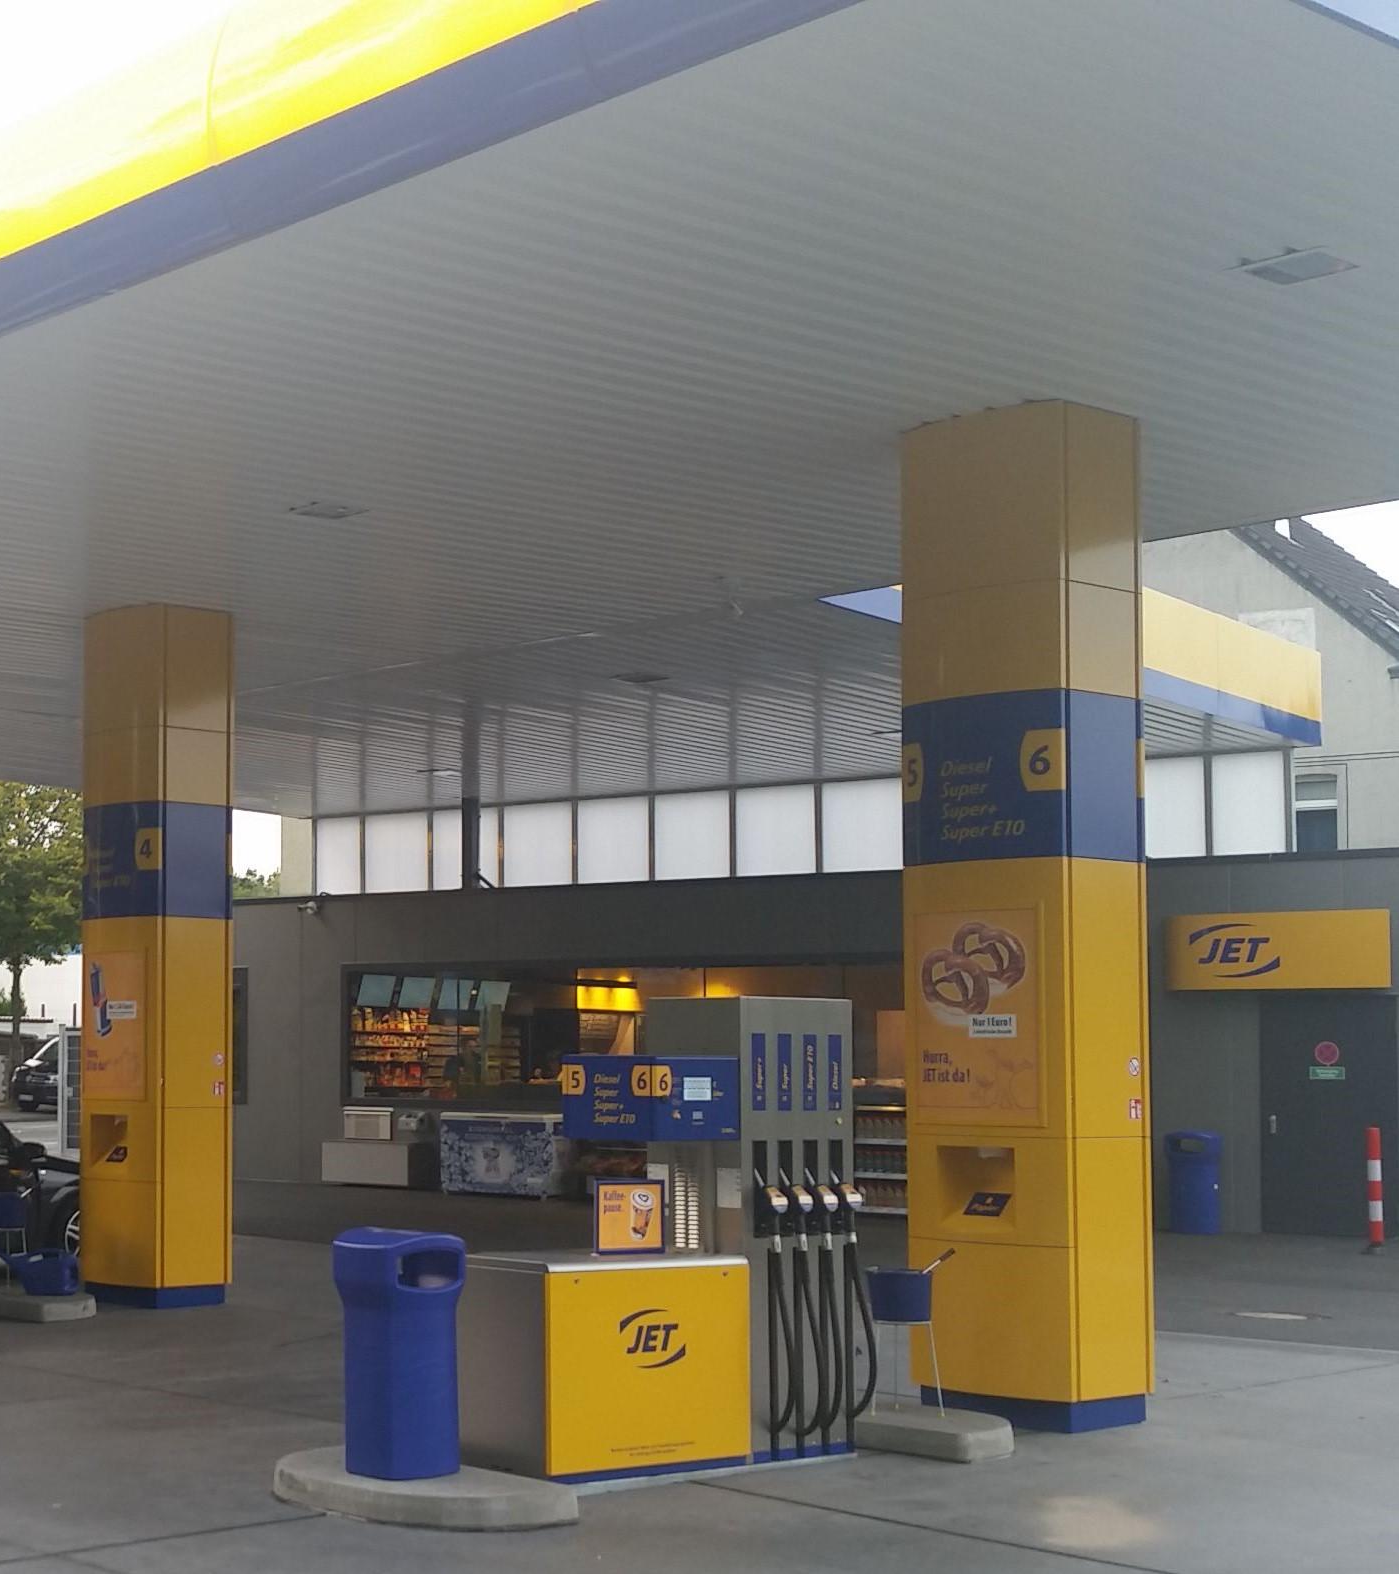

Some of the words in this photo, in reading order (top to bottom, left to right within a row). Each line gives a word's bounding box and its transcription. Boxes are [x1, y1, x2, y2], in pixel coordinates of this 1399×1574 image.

[940, 755, 993, 777] Diesel
[1029, 744, 1051, 776] 6
[906, 757, 918, 788] 5
[940, 781, 988, 800] Super
[940, 803, 998, 822] Super+
[940, 825, 989, 844] Super
[991, 819, 1026, 836] E10
[139, 839, 153, 859] 4
[1198, 937, 1270, 965] JET
[972, 1017, 986, 1027] Nur
[806, 1044, 814, 1062] E10
[922, 1049, 953, 1065] Hurra,
[571, 1070, 581, 1089] 5
[593, 1073, 621, 1084] Diesel
[637, 1071, 647, 1090] 6
[659, 1073, 669, 1092] 6
[755, 1057, 764, 1089] Super+
[781, 1063, 790, 1089] Super
[807, 1062, 816, 1089] Super
[922, 1067, 937, 1082] JET
[937, 1068, 950, 1082] ist
[593, 1087, 619, 1100] Super
[593, 1099, 624, 1113] Super+
[593, 1112, 620, 1126] Super
[619, 1113, 636, 1125] E10
[626, 1323, 679, 1355] JET
